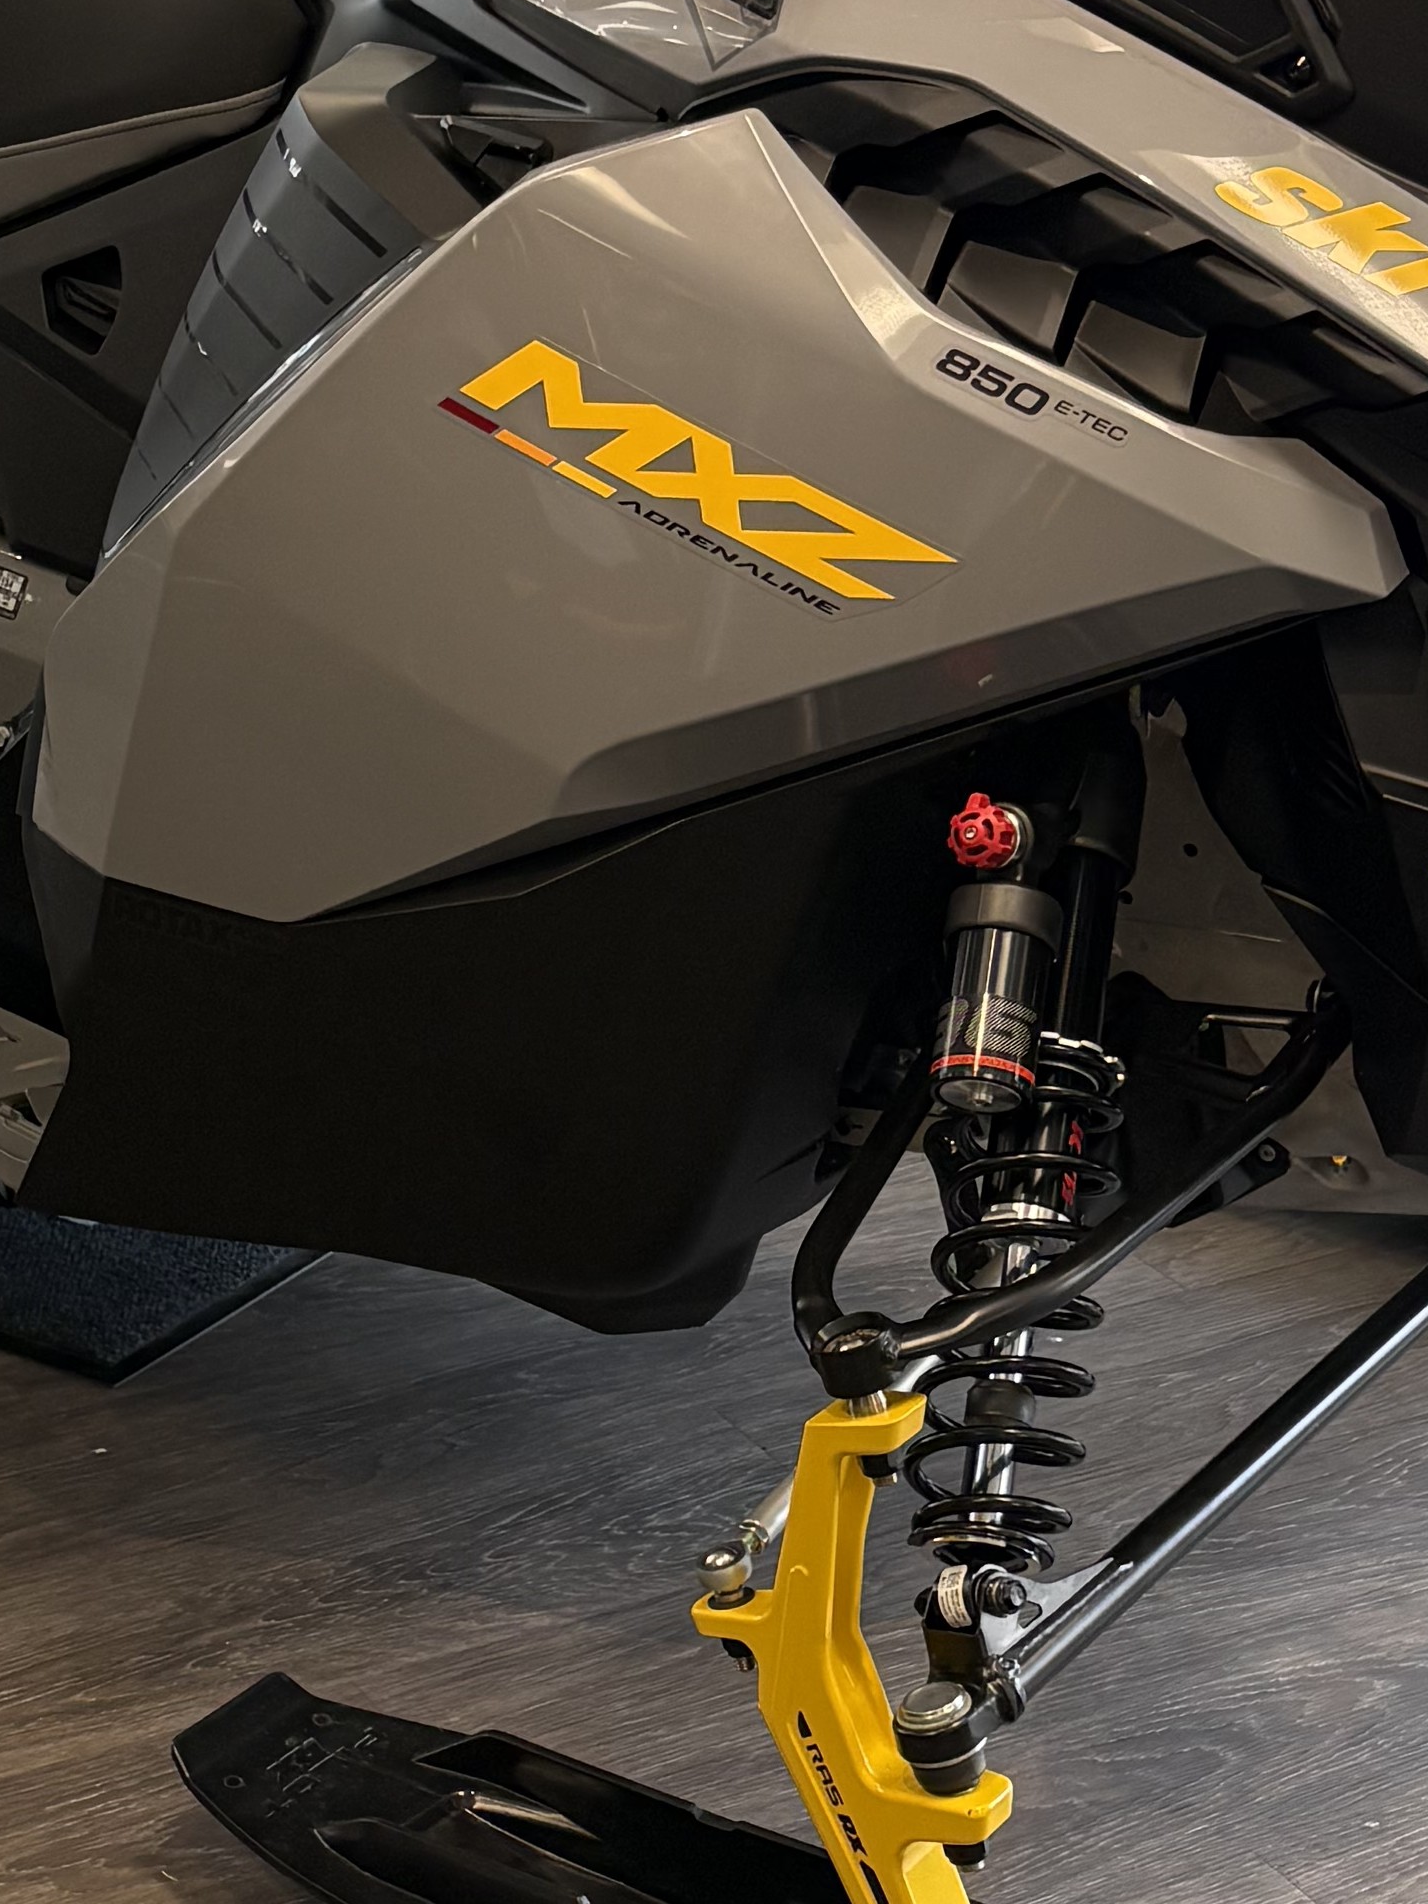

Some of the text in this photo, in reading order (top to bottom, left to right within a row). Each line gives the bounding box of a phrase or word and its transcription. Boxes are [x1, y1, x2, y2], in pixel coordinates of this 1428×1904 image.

[935, 347, 1129, 443] 850 E-TEC
[458, 340, 959, 600] MXZ
[617, 500, 842, 617] ADRENALINE
[806, 1743, 869, 1857] RAS RX
